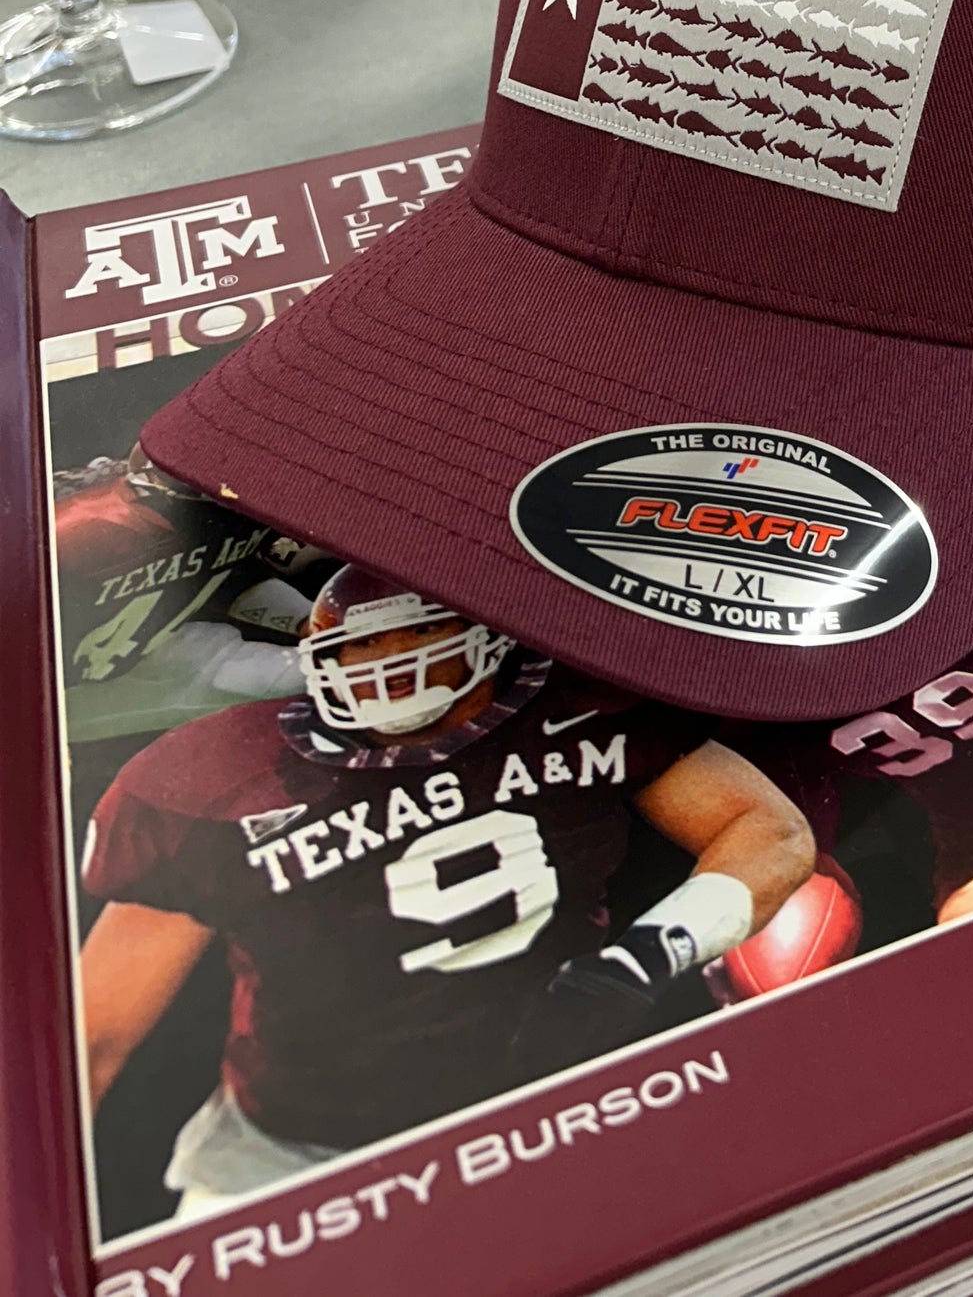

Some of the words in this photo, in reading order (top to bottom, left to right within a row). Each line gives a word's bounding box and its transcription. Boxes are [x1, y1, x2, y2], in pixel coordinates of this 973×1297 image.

[651, 433, 705, 451] THE
[712, 434, 832, 474] ORIGINAL
[615, 497, 848, 558] FLEXFIT
[94, 545, 208, 606] TEXAS
[609, 573, 640, 593] IT
[643, 586, 703, 616] FITS
[710, 603, 783, 630] YOUR
[247, 771, 466, 894] TEXAS
[494, 733, 627, 804] A&M
[384, 809, 560, 973] 9
[212, 1160, 441, 1281] RUSTY
[454, 1050, 730, 1184] BURSON
